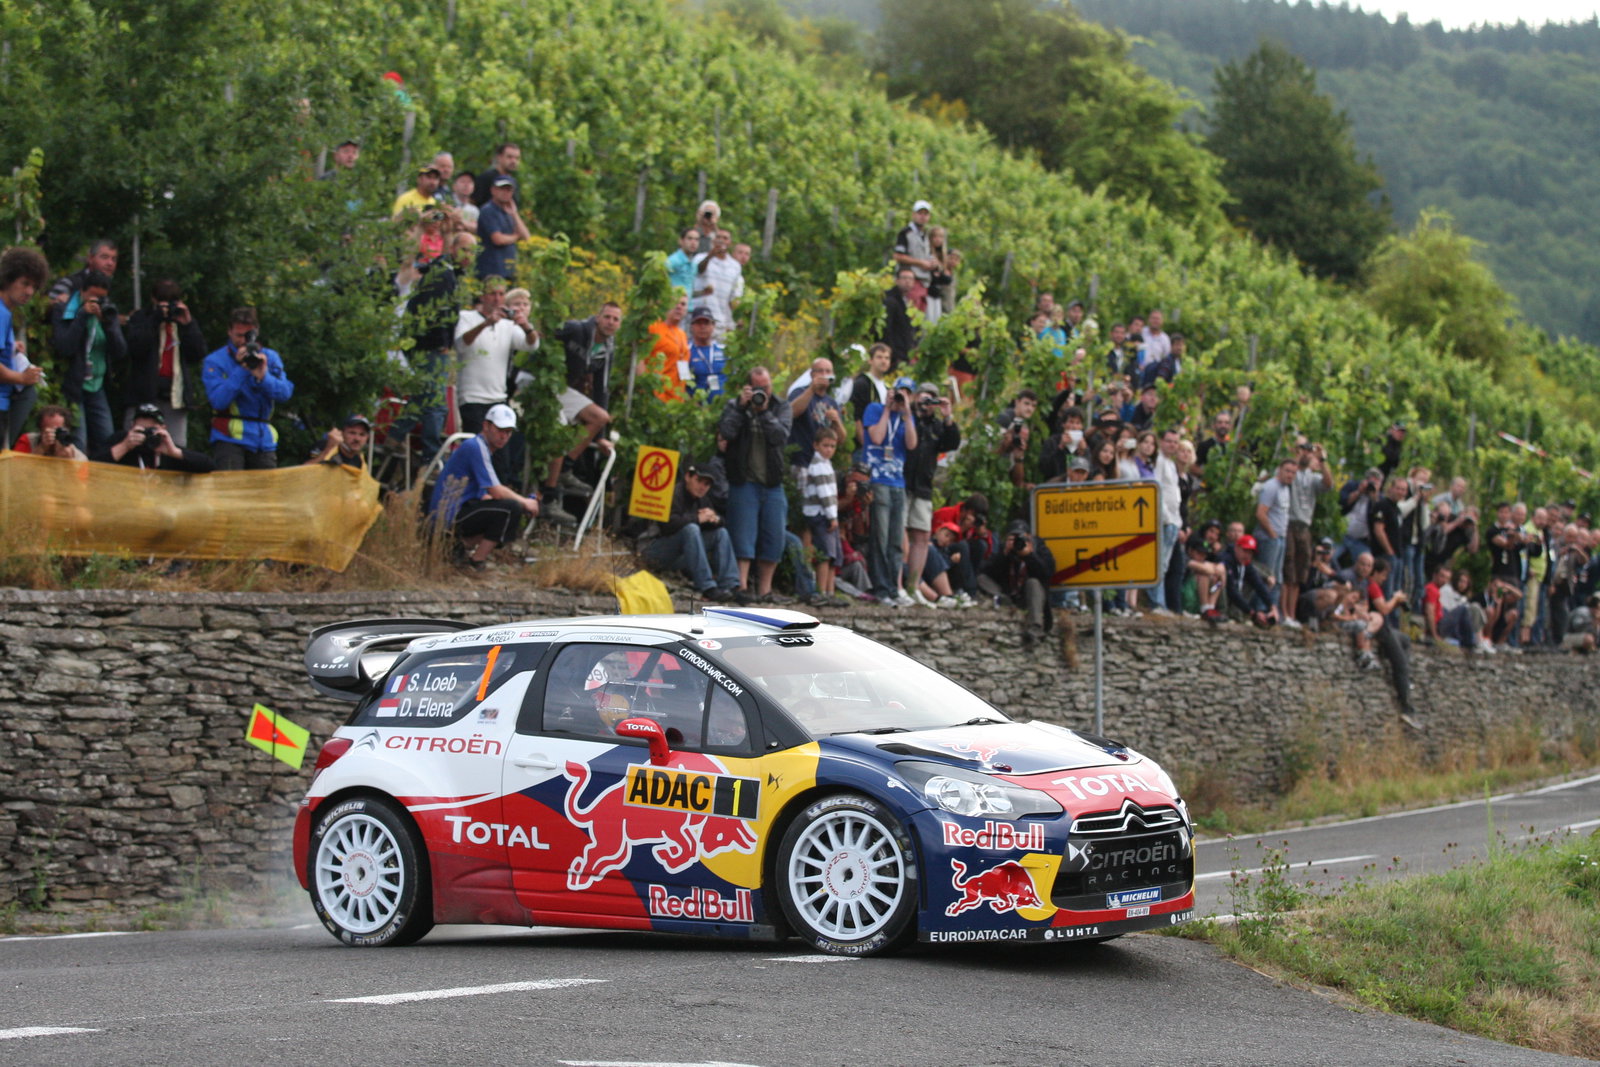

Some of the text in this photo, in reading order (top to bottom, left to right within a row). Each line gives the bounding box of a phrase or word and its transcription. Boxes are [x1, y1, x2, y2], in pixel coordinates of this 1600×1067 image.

[1044, 497, 1127, 514] Büdlicherbrück
[1075, 547, 1119, 572] Fell
[407, 673, 457, 692] S. Loeb
[476, 645, 501, 701] 1
[399, 697, 453, 718] D. Elena
[626, 723, 656, 733] TOTAL
[629, 769, 711, 811] ADAC
[1051, 773, 1160, 801] TOTAL
[732, 779, 742, 817] 1
[444, 815, 550, 850] TOTAL
[1089, 864, 1176, 885] RACING
[1121, 889, 1158, 903] MICHELIN
[930, 929, 1027, 942] EURODATACAR
[1057, 926, 1099, 938] LUHTA
